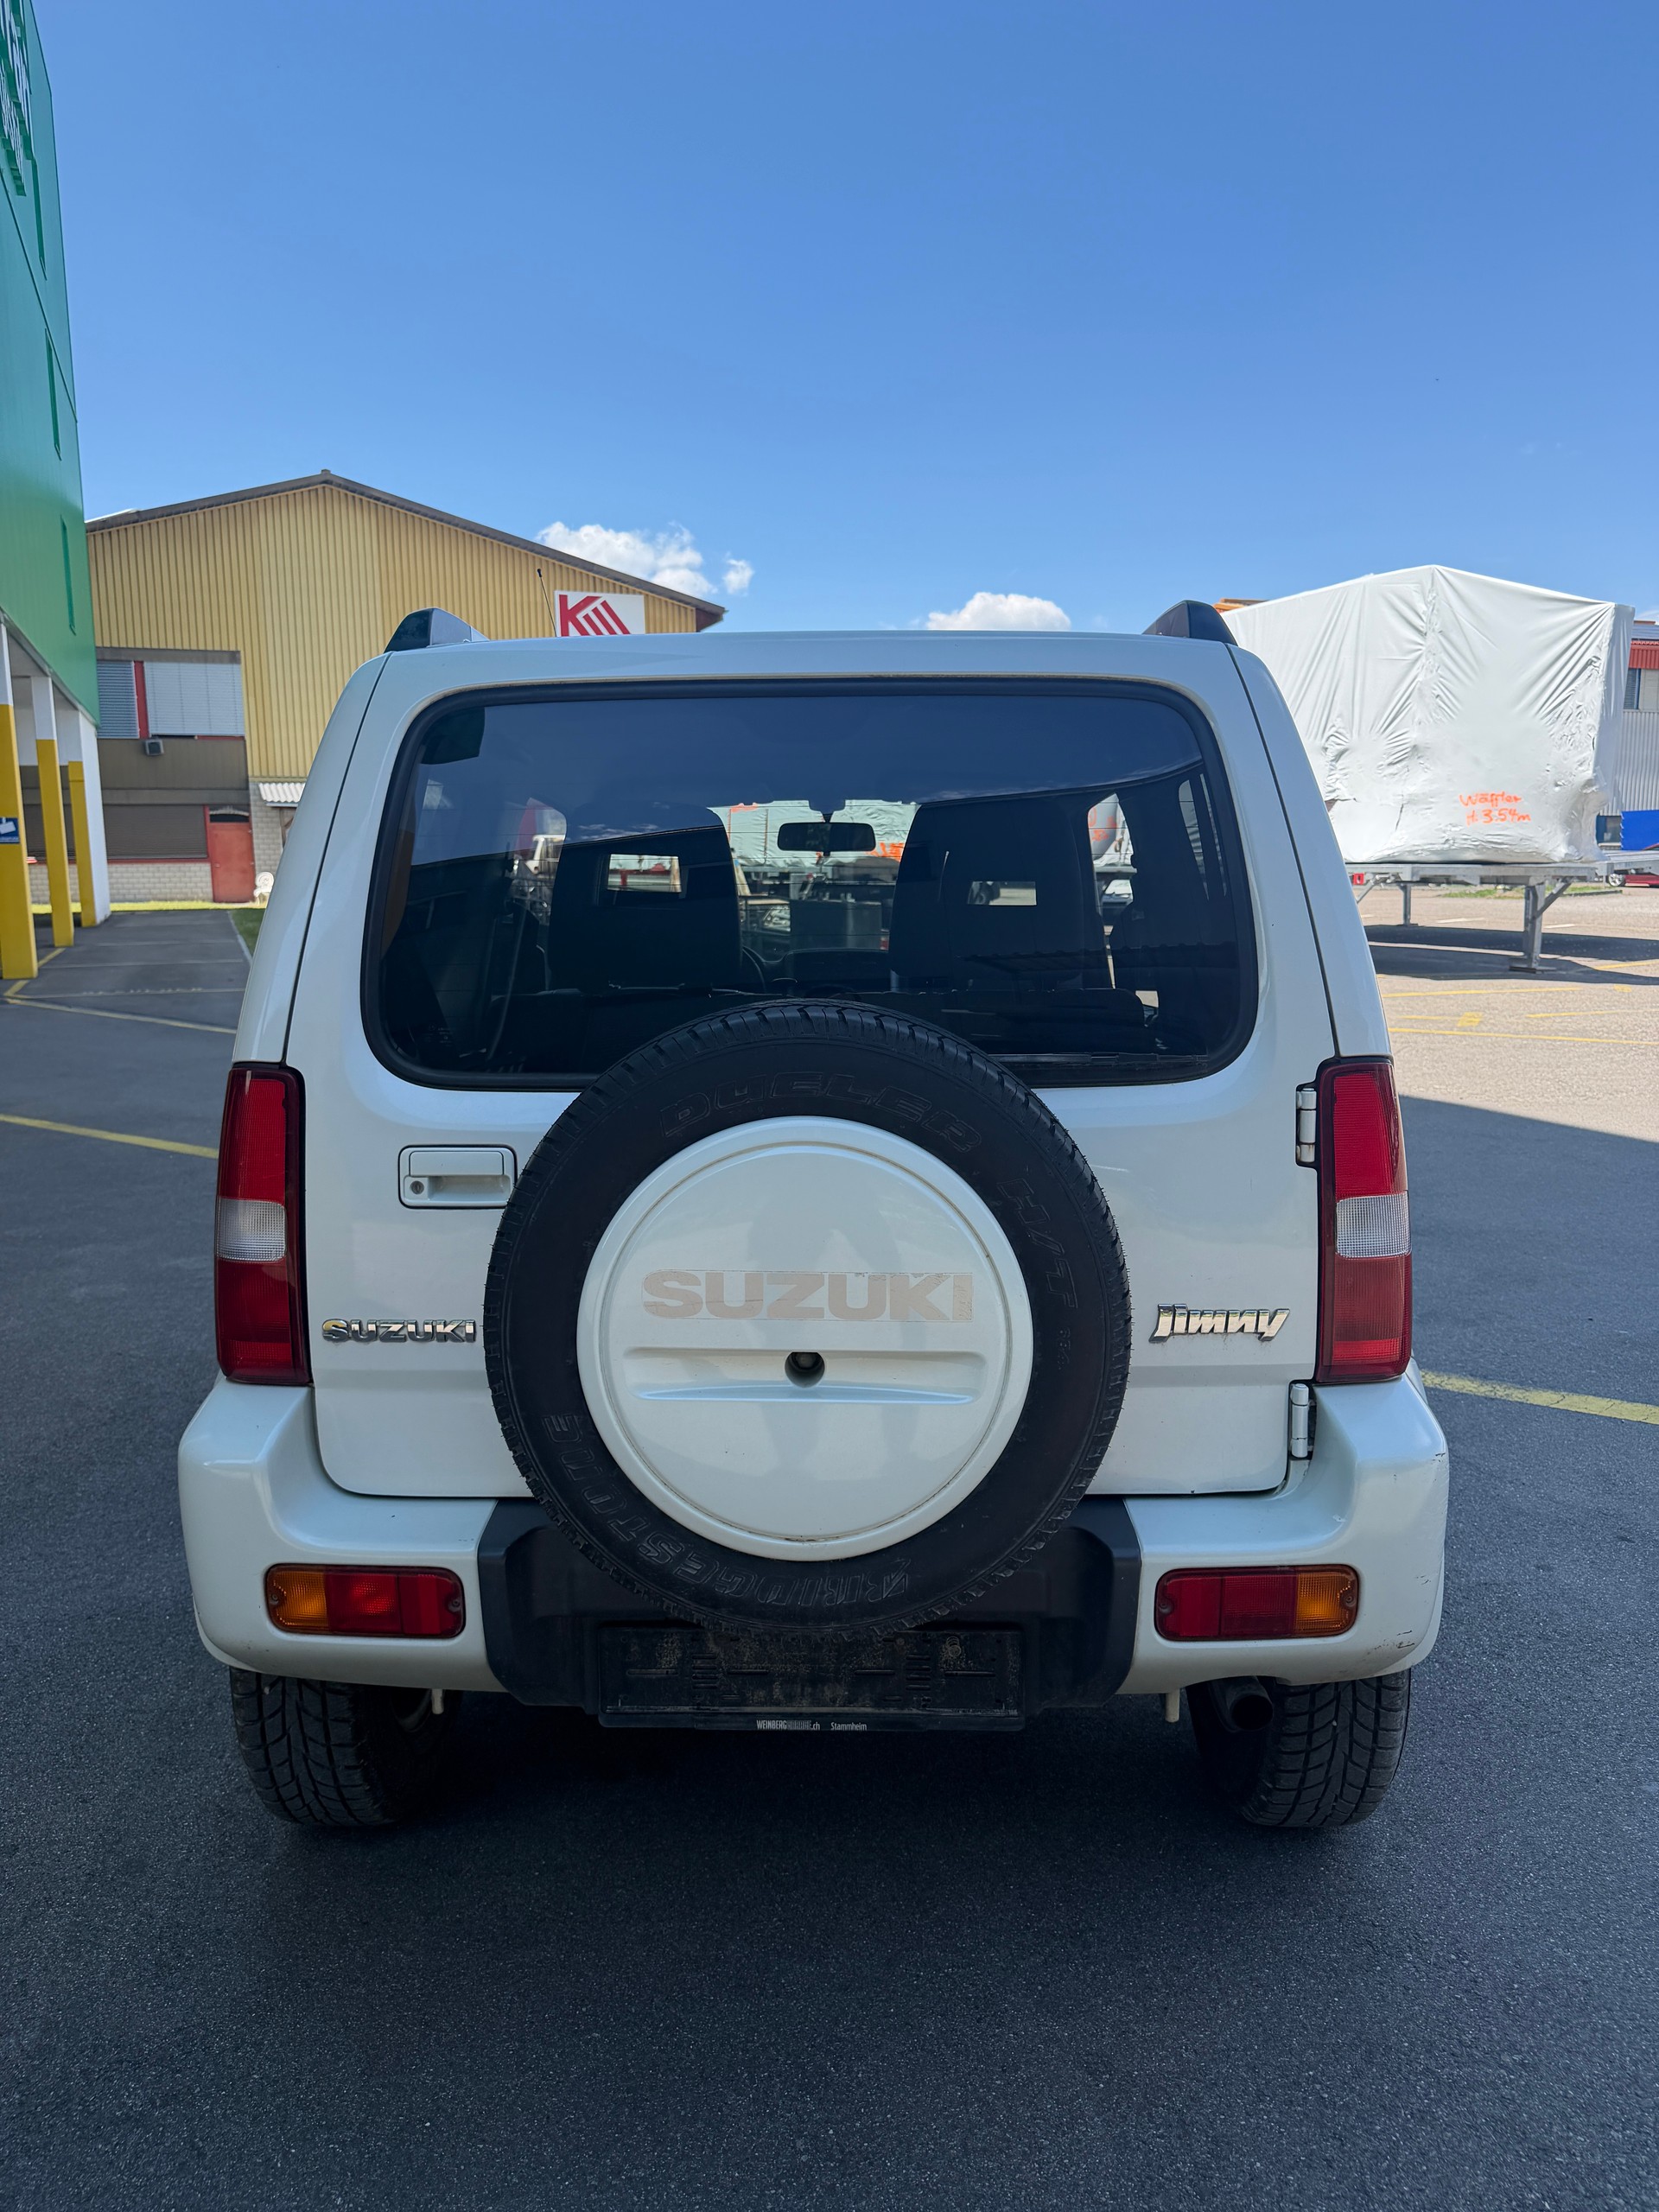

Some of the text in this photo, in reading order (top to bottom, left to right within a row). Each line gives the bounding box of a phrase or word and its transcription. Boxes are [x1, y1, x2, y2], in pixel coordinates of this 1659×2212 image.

[642, 1270, 974, 1321] SUZUKI
[322, 1319, 476, 1343] SUZUKI
[543, 1414, 912, 1607] BRIDGESTONE
[830, 1721, 868, 1731] Stammheim
